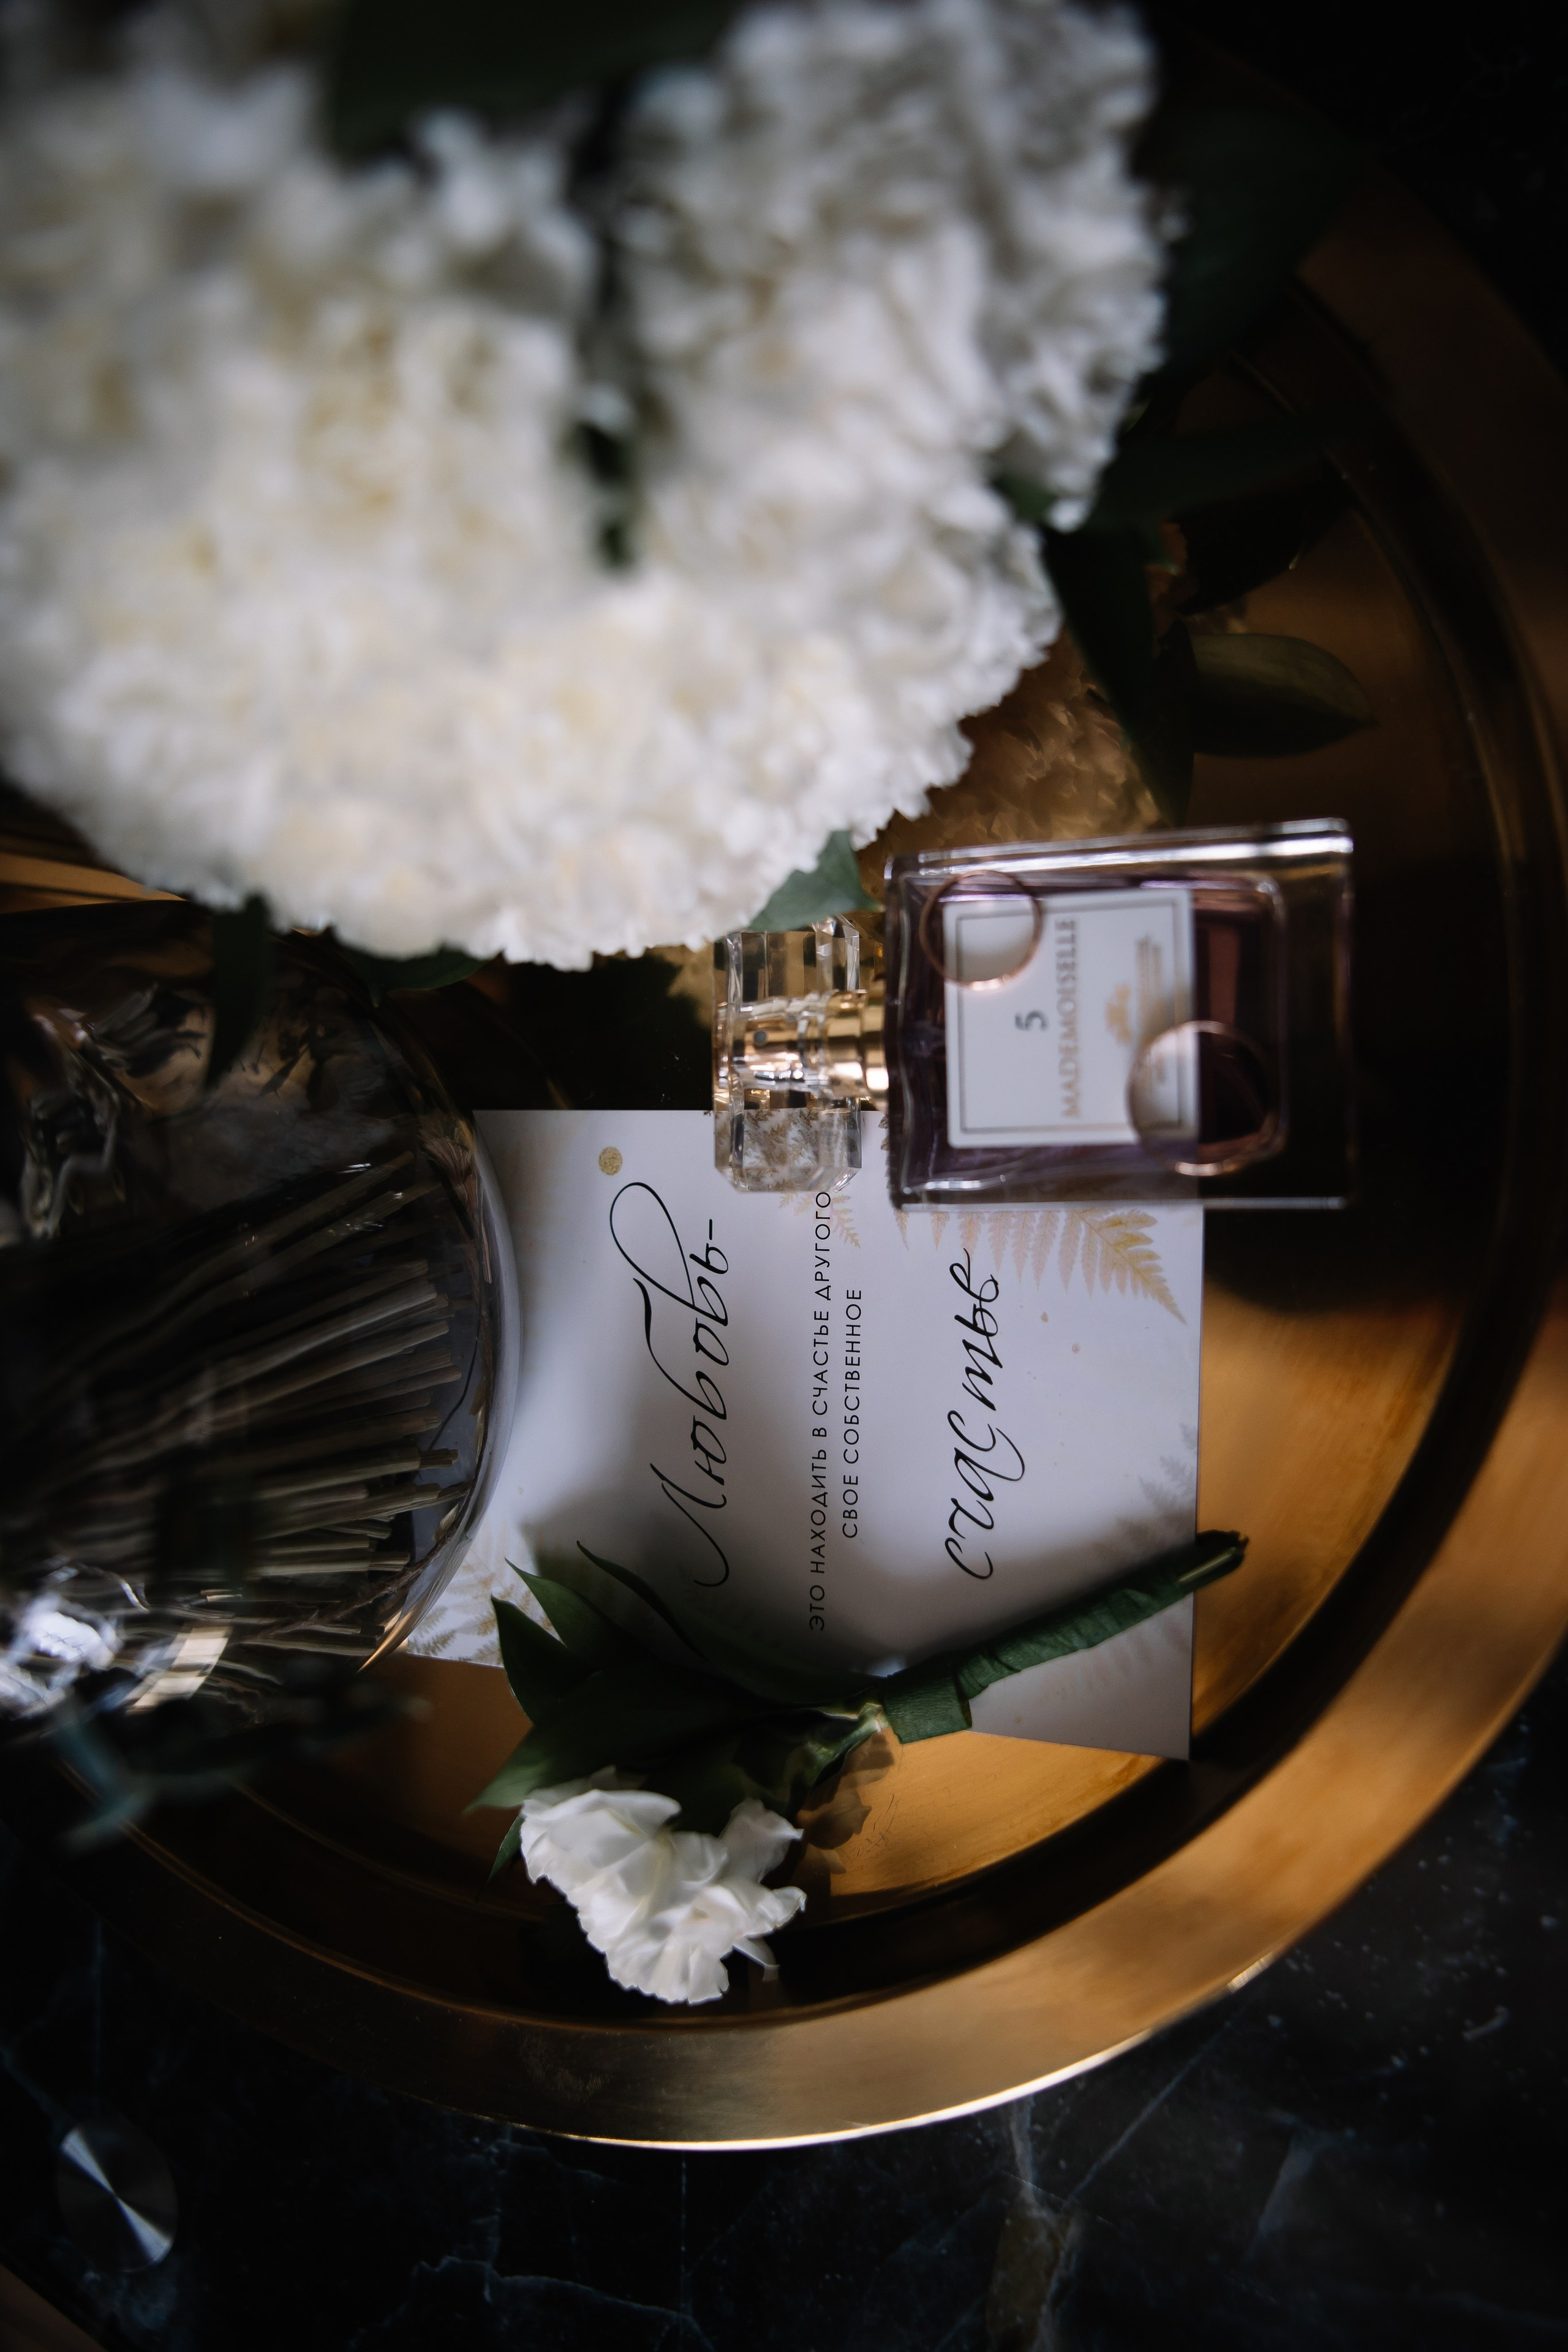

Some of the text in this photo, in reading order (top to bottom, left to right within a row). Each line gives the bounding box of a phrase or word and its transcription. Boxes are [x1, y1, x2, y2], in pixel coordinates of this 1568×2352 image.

[1014, 1011, 1047, 1033] 5
[1055, 919, 1080, 1118] MADEMOISELLE
[809, 1192, 832, 1632] ЭТО НАХОДИТЬ В СЧАСТЬЕ ДРУГОГО
[842, 1290, 862, 1539] СВОЕ СОБСТВЕННОЕ
[944, 1247, 1025, 1581] счастье
